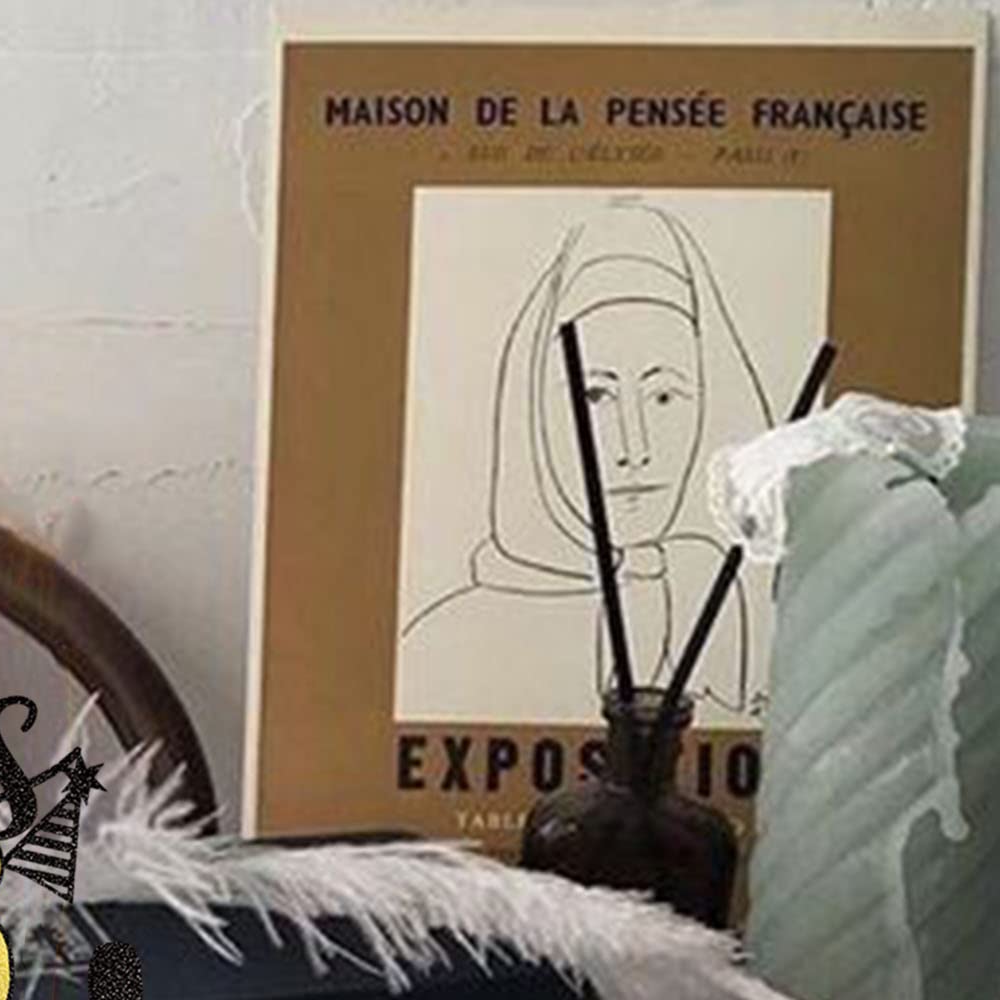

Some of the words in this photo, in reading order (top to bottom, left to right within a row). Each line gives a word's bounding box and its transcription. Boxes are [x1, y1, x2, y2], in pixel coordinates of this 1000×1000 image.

[325, 96, 449, 128] MAISON
[475, 96, 518, 128] DE
[540, 97, 580, 128] LA
[606, 89, 726, 128] PENSÉE
[752, 98, 927, 138] FRANÇAISE
[396, 734, 762, 798] EXPOSIO
